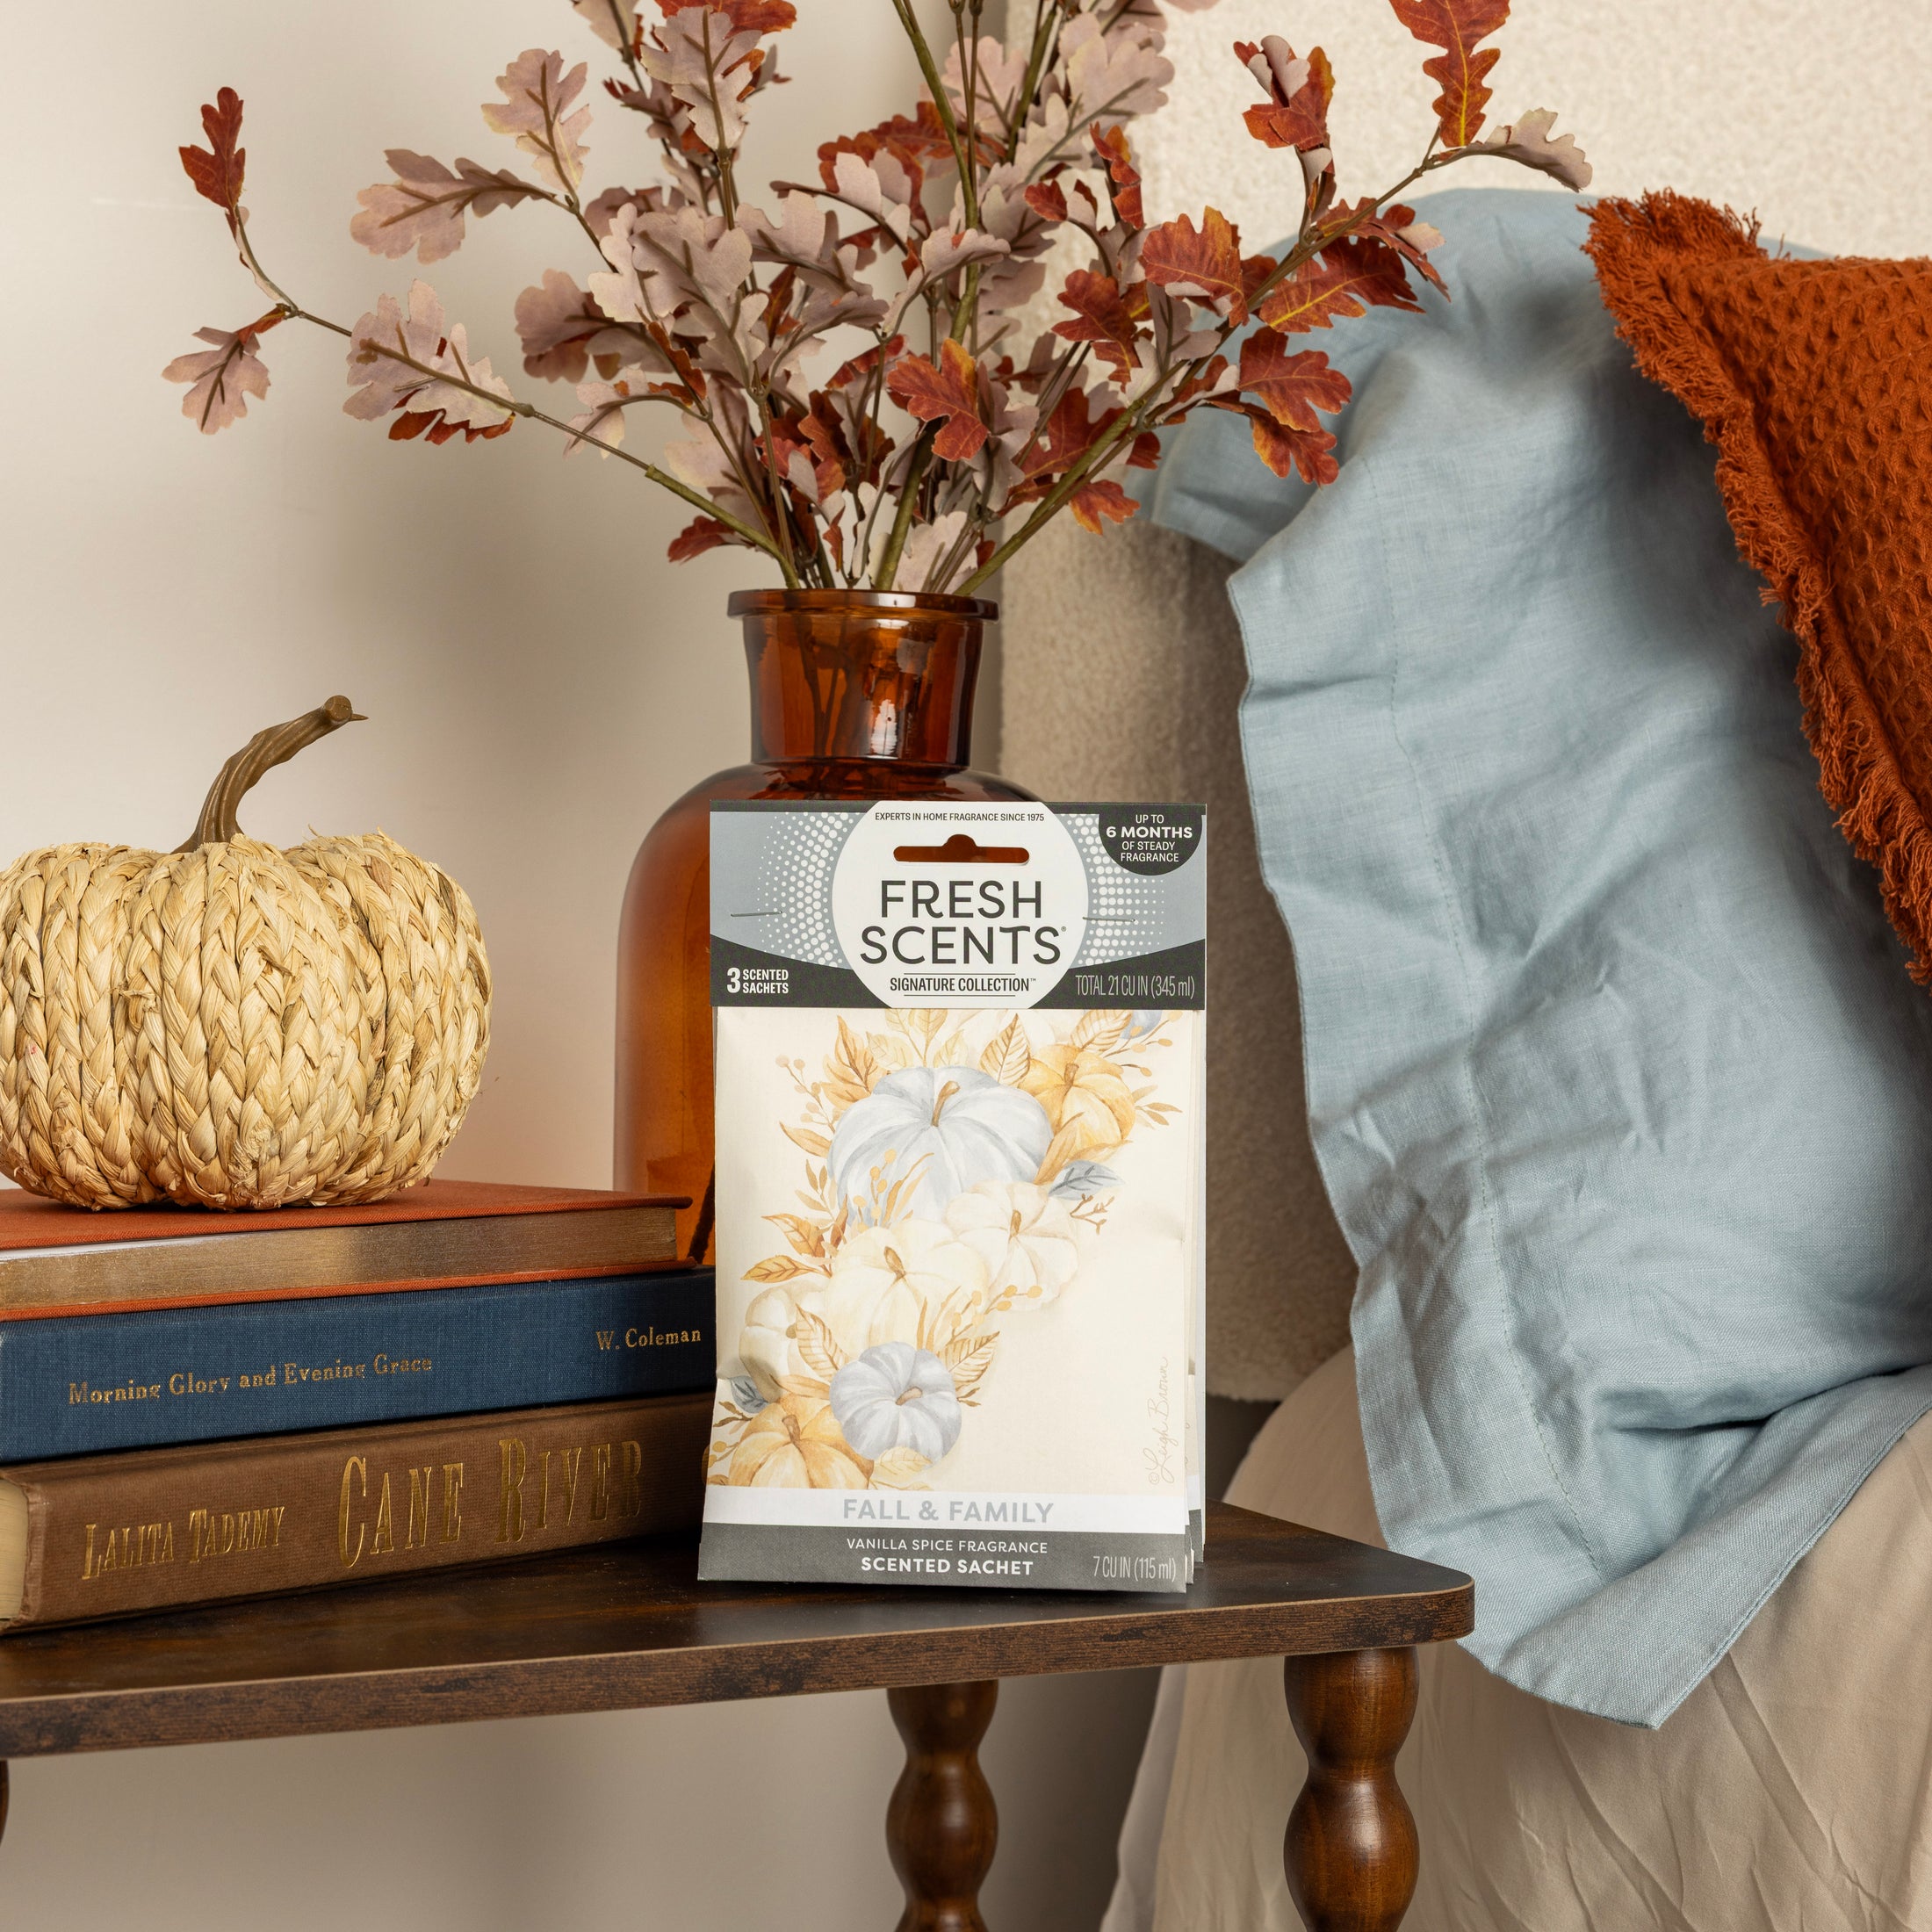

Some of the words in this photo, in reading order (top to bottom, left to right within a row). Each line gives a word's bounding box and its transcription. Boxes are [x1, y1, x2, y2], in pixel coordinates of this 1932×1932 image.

[875, 812, 911, 821] EXPERTS
[912, 812, 921, 821] IN
[923, 812, 948, 821] HOME
[949, 812, 998, 822] FRAGRANCE
[1000, 813, 1026, 822] SINCE
[1027, 813, 1044, 822] 1975
[1135, 814, 1149, 824] UP
[1150, 814, 1164, 824] TO
[1106, 825, 1117, 838] 6
[1121, 826, 1193, 839] MONTHS
[1121, 840, 1135, 851] OF
[1137, 840, 1176, 851] STEADY
[1121, 853, 1179, 862] FRAGRANCE
[881, 880, 1042, 919] FRESH
[726, 967, 741, 993] 3
[742, 969, 789, 981] SCENTED
[890, 977, 955, 992] SIGNATURE
[742, 982, 789, 994] SACHETS
[1075, 975, 1107, 996] TOTAL
[1107, 975, 1119, 996] 21
[1121, 975, 1135, 996] CU
[1137, 975, 1148, 996] IN
[1150, 975, 1176, 999] (345
[1178, 976, 1195, 999] ml)
[595, 1330, 620, 1351] W.
[624, 1326, 702, 1348] Coleman
[68, 1380, 162, 1405] Morning
[169, 1373, 230, 1396] Glory
[238, 1365, 277, 1388] and
[283, 1359, 366, 1385] Evening
[372, 1352, 433, 1375] Grace
[338, 1456, 465, 1568] CANE
[494, 1438, 643, 1545] RIVER
[843, 1498, 910, 1521] FALL
[919, 1500, 940, 1521] &
[949, 1501, 1055, 1524] FAMILY
[82, 1520, 175, 1581] LALITA
[188, 1506, 285, 1564] TADEMY
[847, 1538, 908, 1551] VANILLA
[912, 1539, 954, 1552] SPICE
[959, 1540, 1048, 1554] FRAGRANCE
[861, 1556, 951, 1574] SCENTED
[957, 1559, 1034, 1575] SACHET
[1092, 1555, 1100, 1577] 7
[1102, 1555, 1117, 1578] CU
[1120, 1556, 1131, 1578] IN
[1134, 1556, 1157, 1582] (115
[1158, 1557, 1177, 1582] ml)
